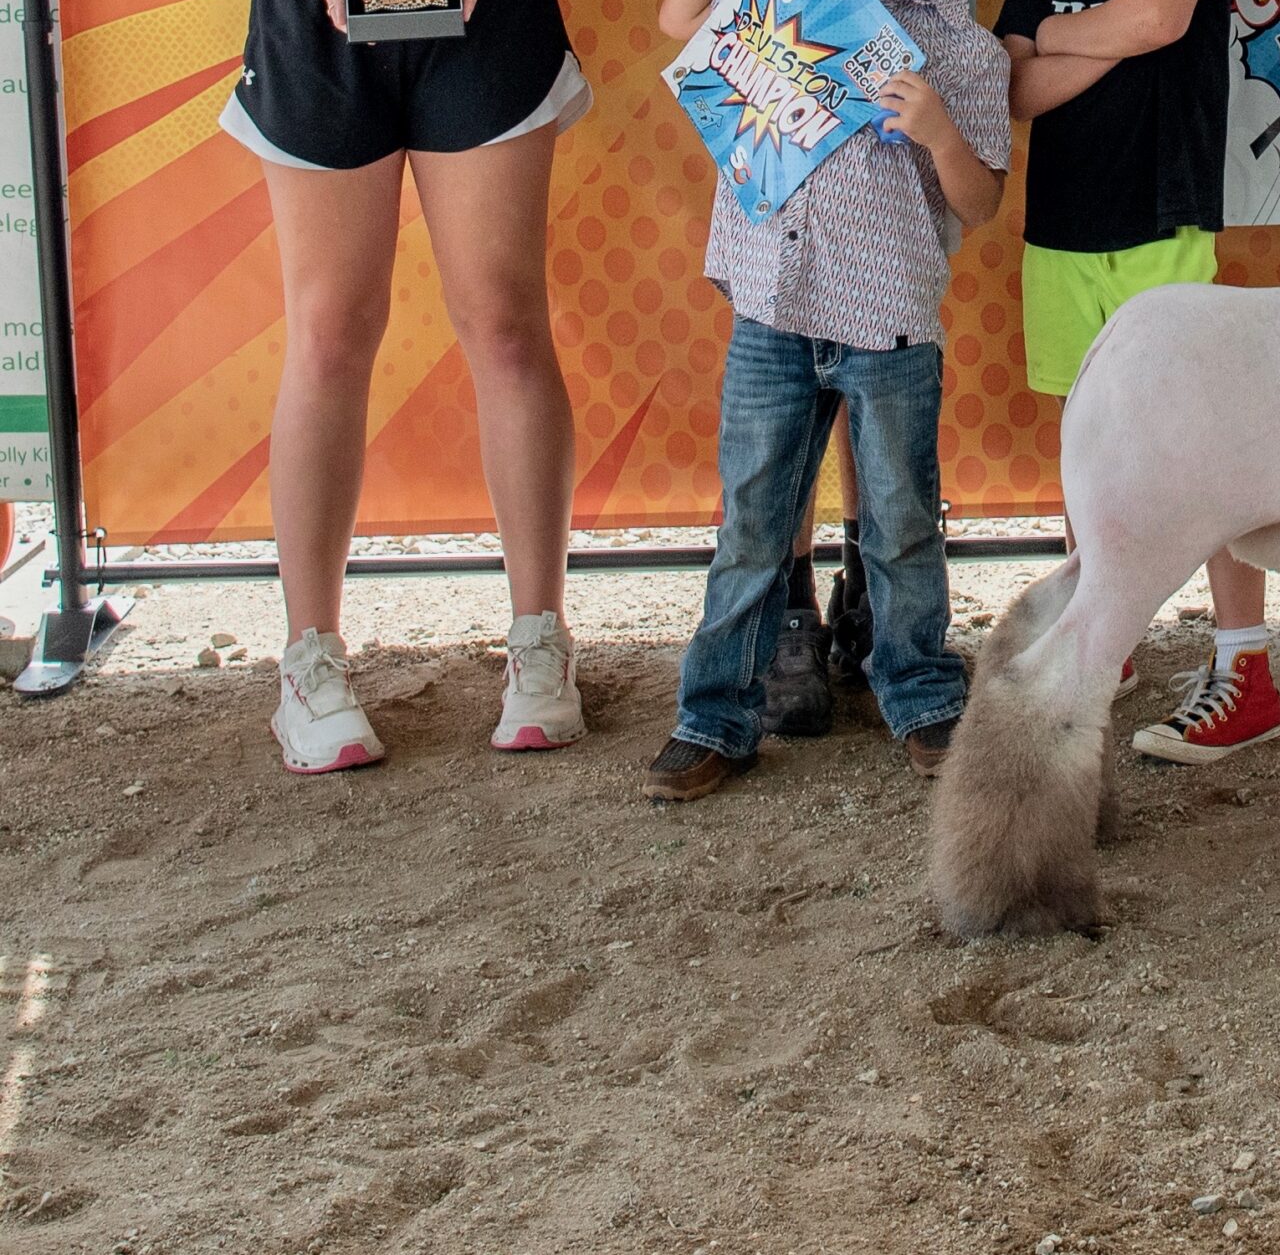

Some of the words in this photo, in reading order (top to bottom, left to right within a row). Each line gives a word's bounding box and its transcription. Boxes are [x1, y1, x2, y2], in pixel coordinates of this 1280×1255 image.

[736, 9, 849, 112] DIVISION
[876, 30, 903, 69] YOUT
[881, 24, 907, 55] HEARTL
[709, 31, 844, 152] CHAMPION
